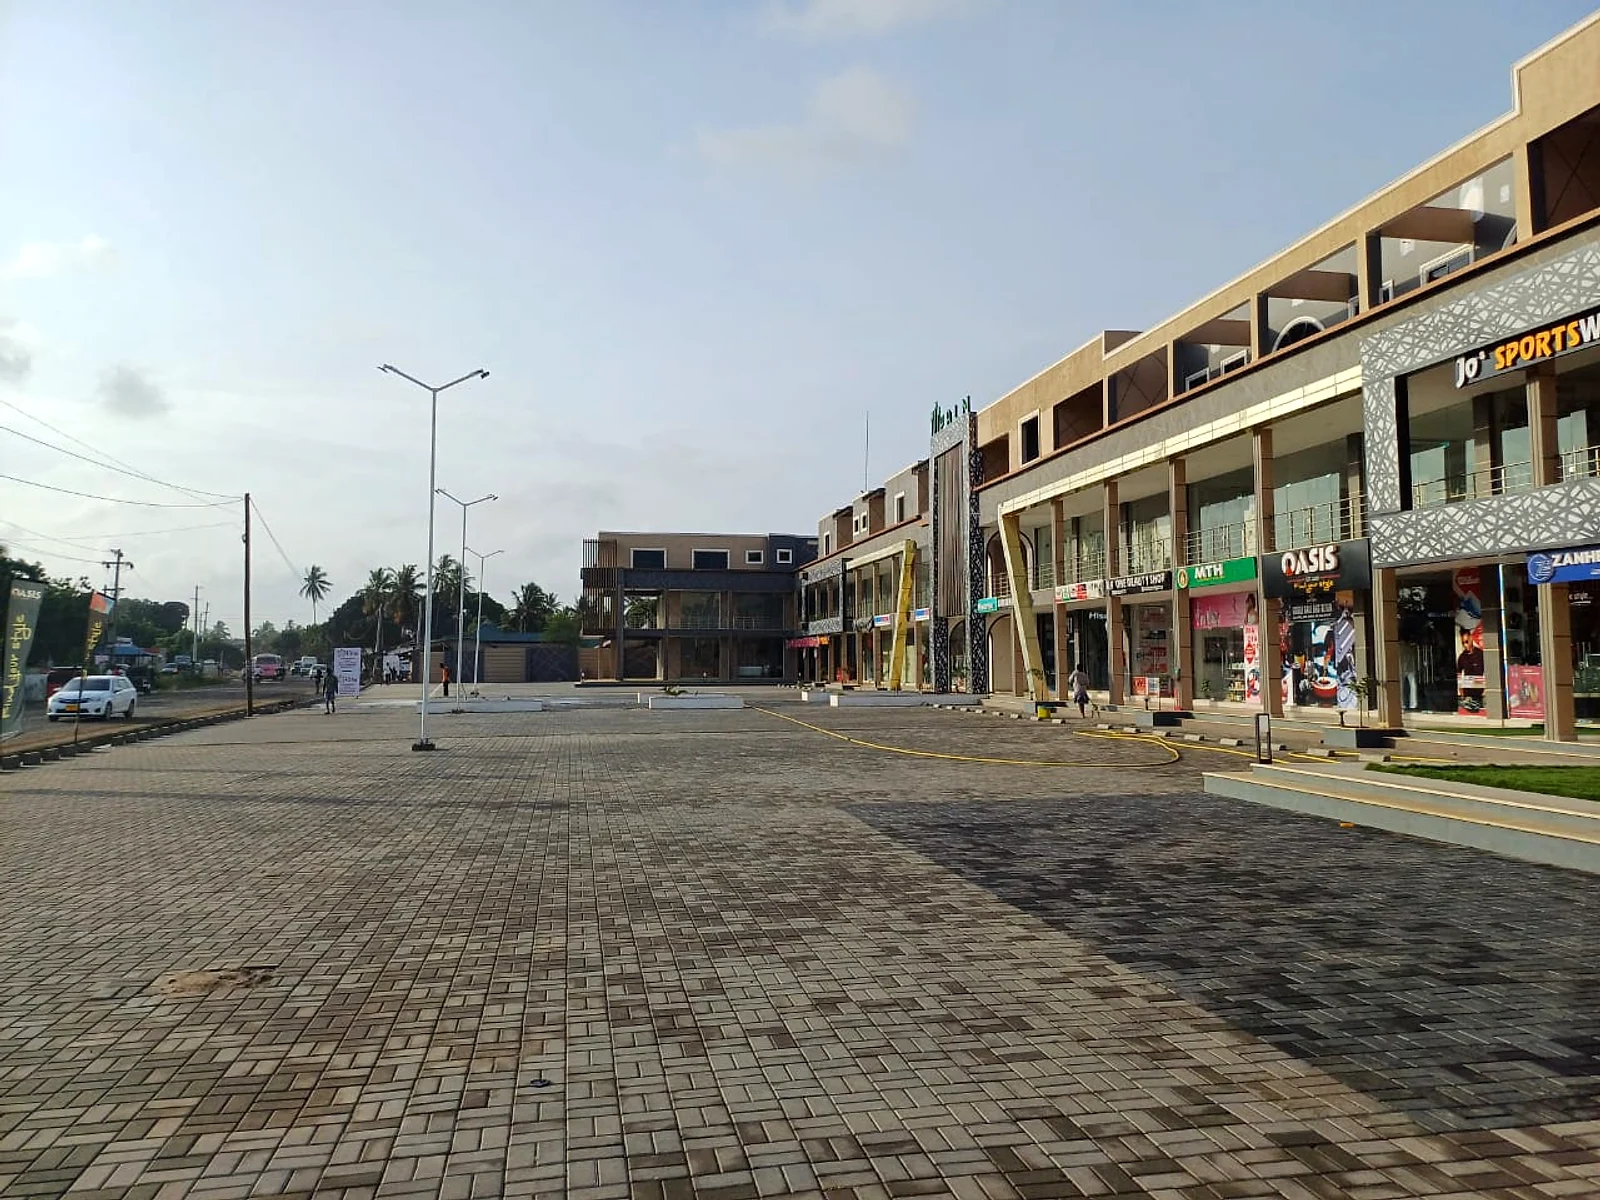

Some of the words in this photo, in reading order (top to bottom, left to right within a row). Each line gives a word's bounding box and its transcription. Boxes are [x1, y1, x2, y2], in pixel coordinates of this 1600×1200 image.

[1194, 563, 1224, 579] MTH
[1281, 545, 1337, 576] OASIS
[11, 588, 42, 599] OASIS
[10, 614, 32, 649] style
